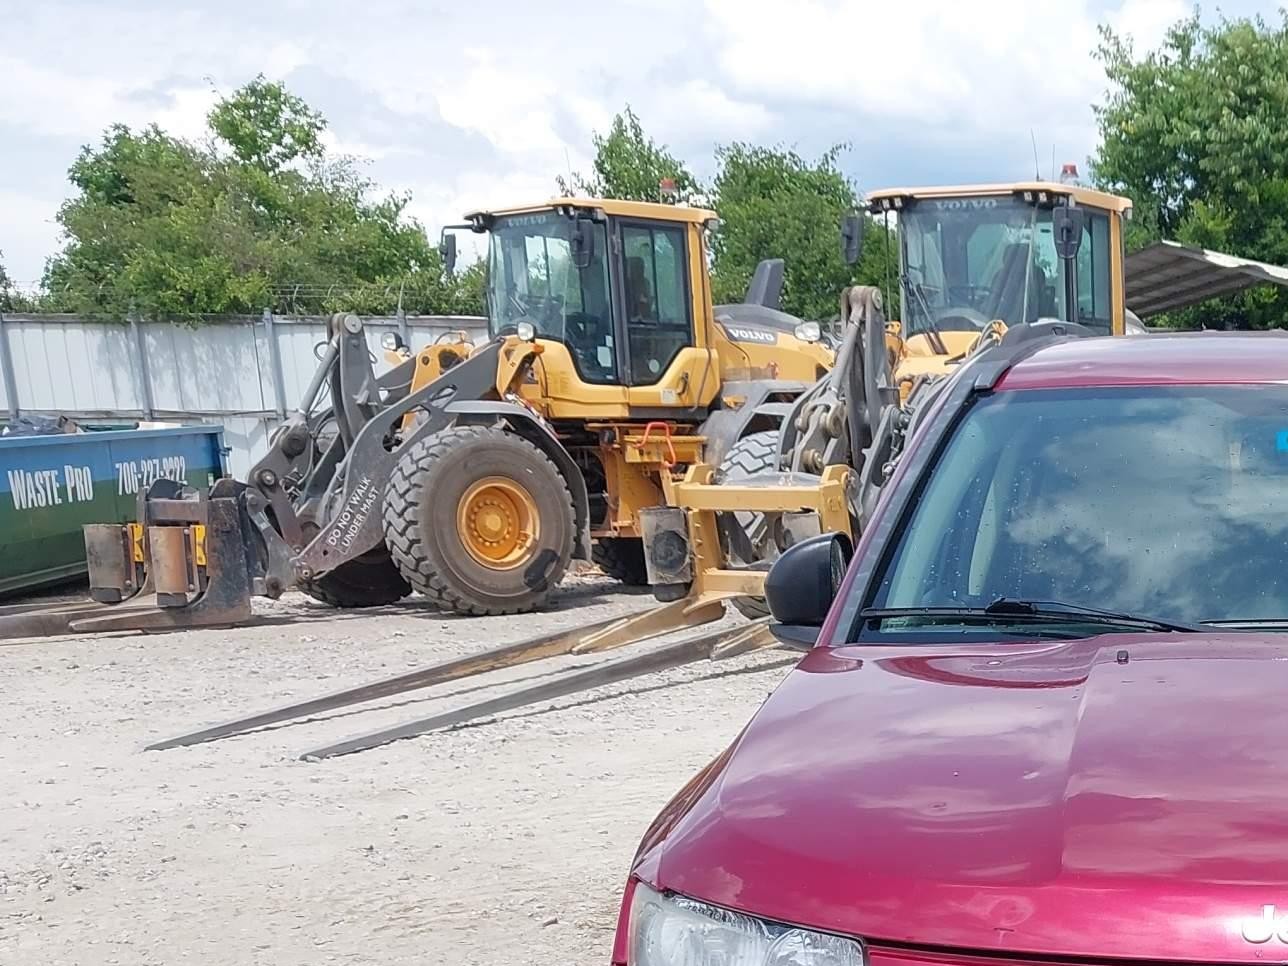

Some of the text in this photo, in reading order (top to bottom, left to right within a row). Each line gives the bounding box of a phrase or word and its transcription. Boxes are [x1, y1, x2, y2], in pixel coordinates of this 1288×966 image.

[935, 199, 998, 211] VOLVO
[507, 215, 547, 227] VOLVO
[728, 328, 775, 341] VOLVO
[328, 477, 371, 546] DO NOT WALK
[341, 486, 380, 547] UNDER MAST
